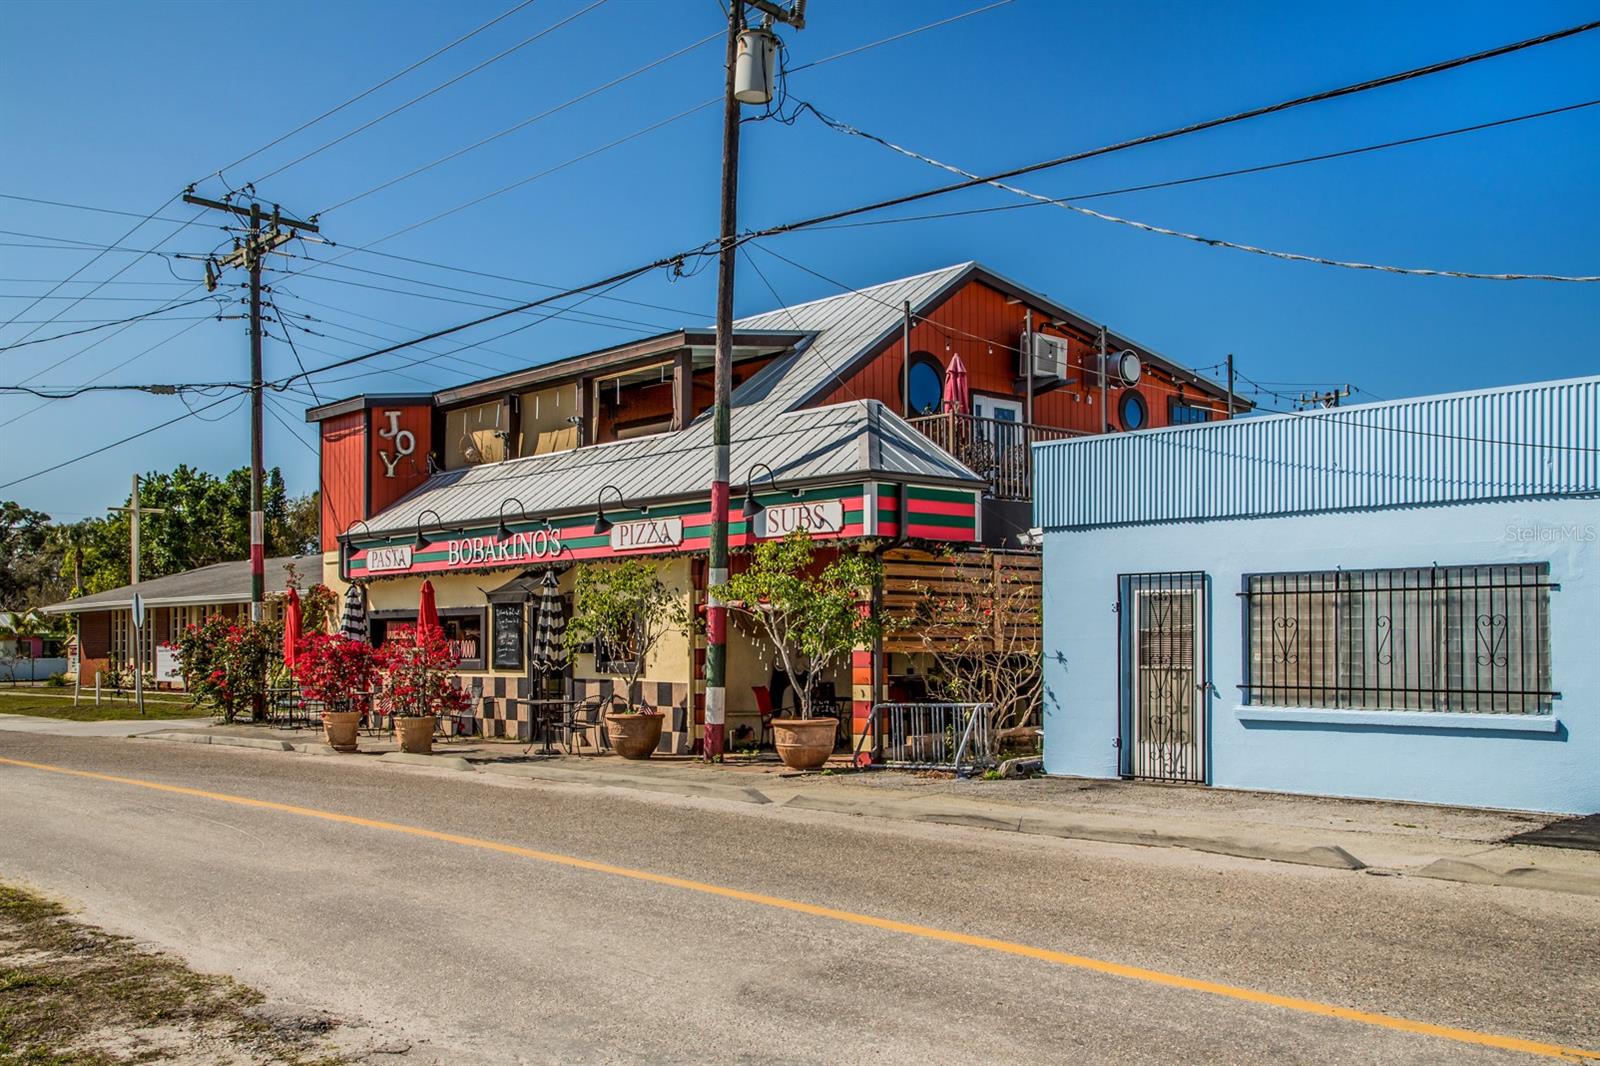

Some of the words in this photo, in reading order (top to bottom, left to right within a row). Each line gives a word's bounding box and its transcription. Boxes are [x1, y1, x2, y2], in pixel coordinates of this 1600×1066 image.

[378, 410, 416, 478] JOY
[767, 505, 826, 533] SUBS
[448, 528, 562, 565] BOBARINO'S
[619, 521, 671, 546] PIZZA
[371, 548, 407, 569] PASTA
